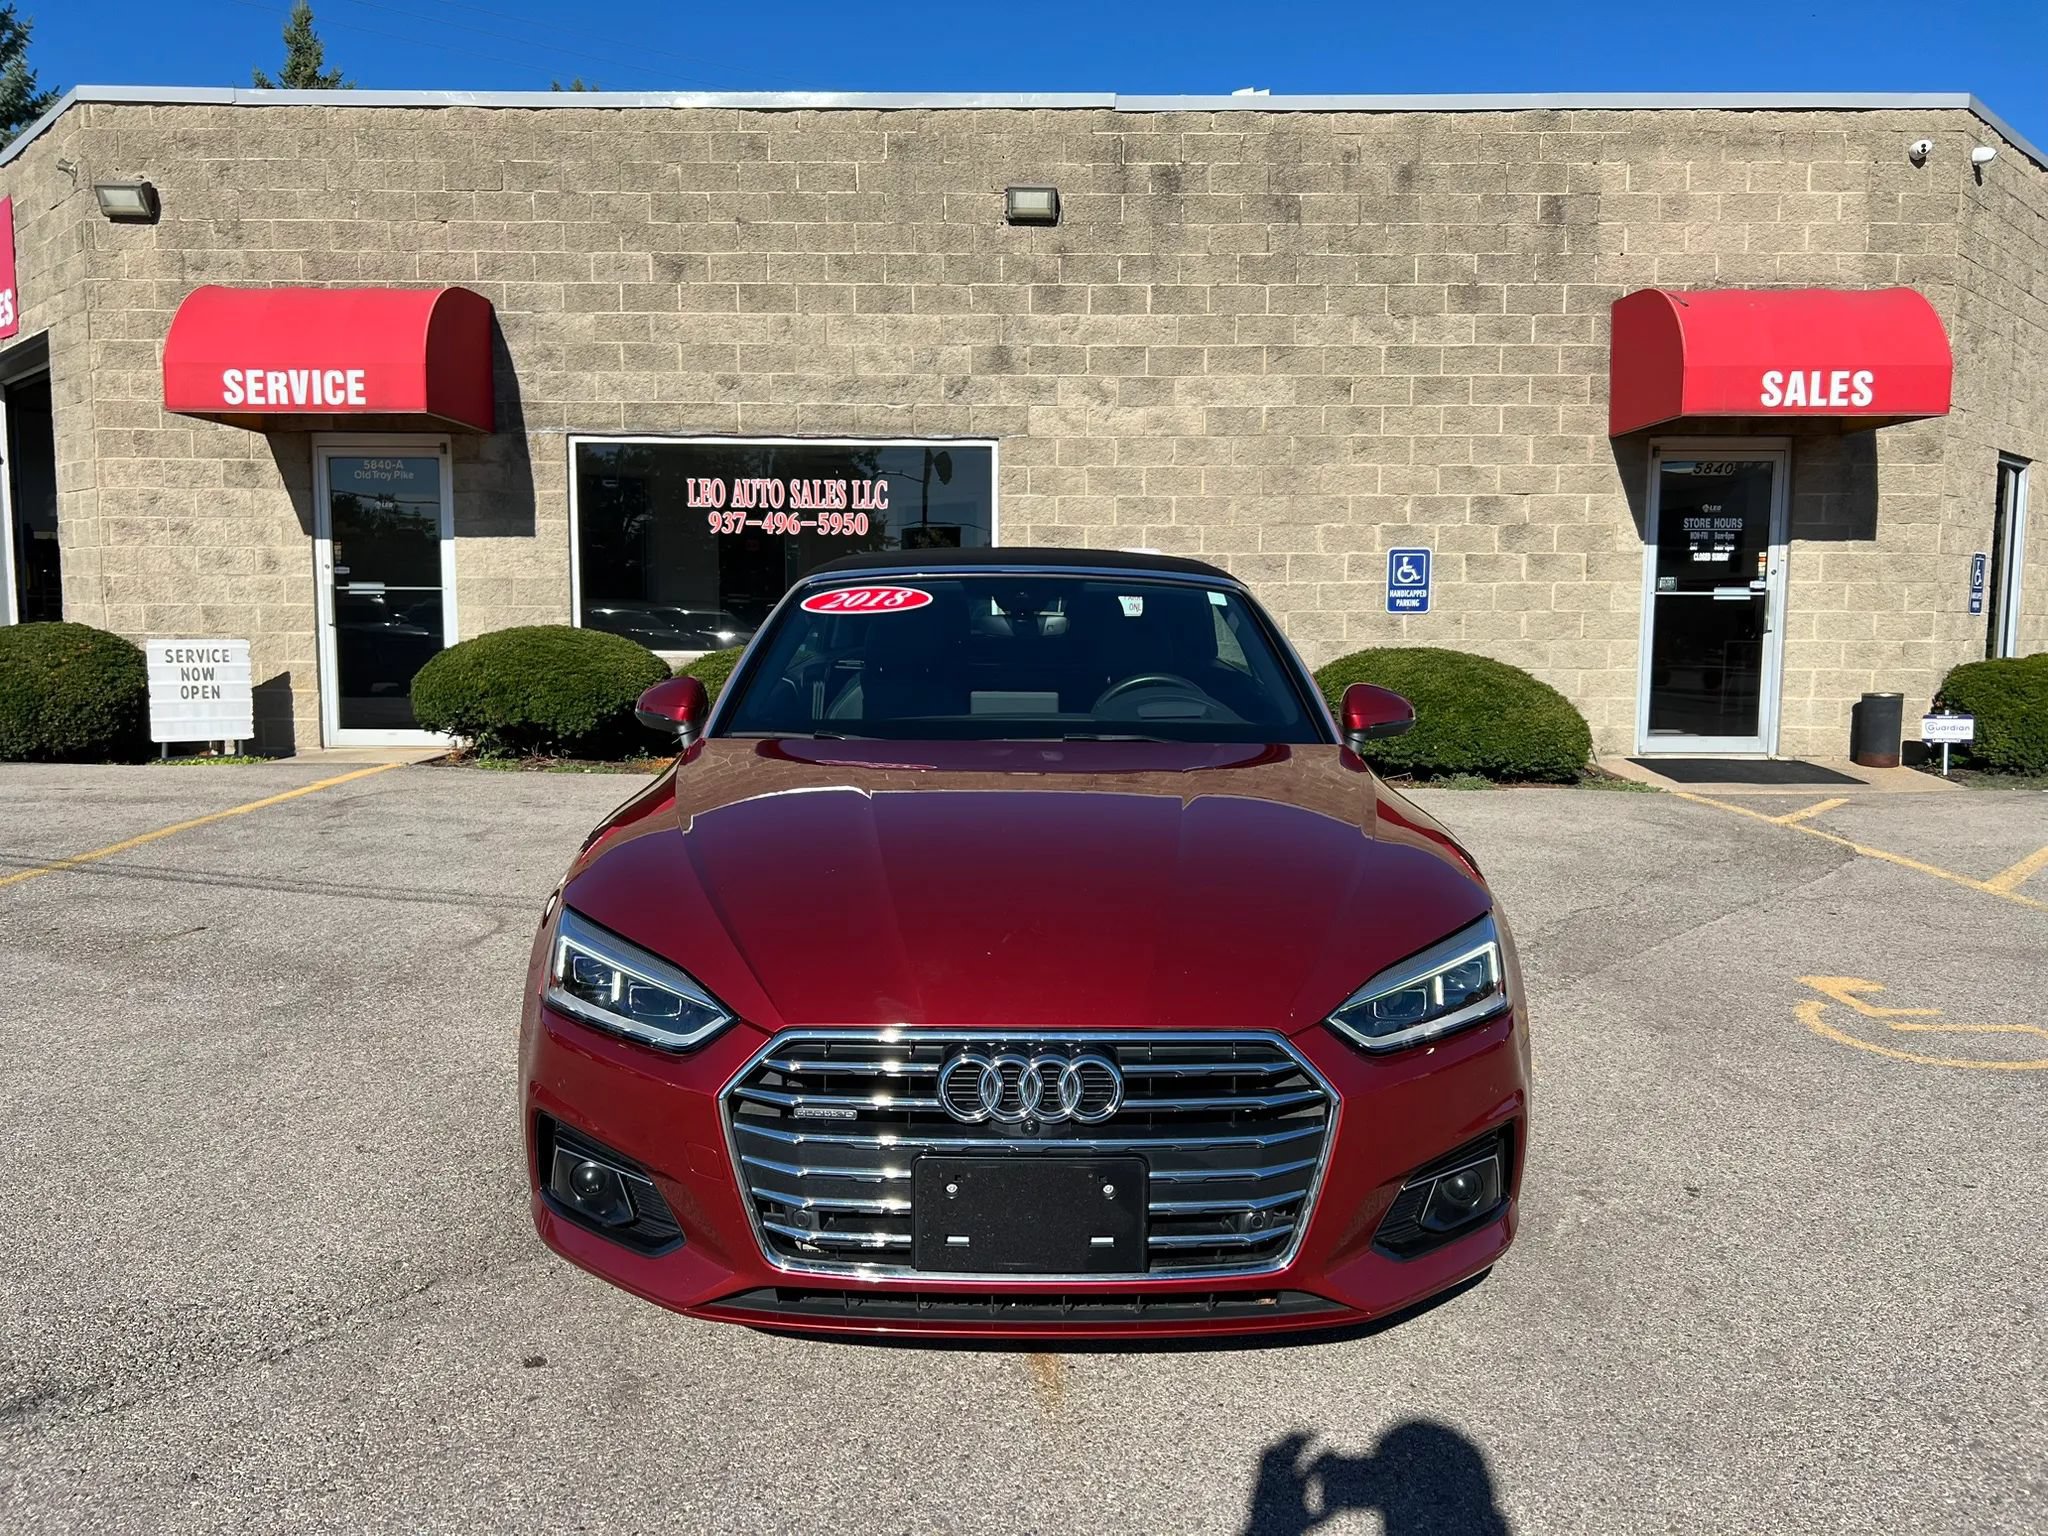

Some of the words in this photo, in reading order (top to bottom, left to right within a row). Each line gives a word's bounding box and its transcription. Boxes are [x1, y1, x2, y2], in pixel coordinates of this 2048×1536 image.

[223, 369, 366, 405] SERVICE
[1760, 370, 1874, 408] SALES
[363, 460, 404, 470] 5840-A
[1692, 462, 1735, 475] 5840
[354, 471, 372, 479] Old
[373, 471, 392, 481] Troy
[393, 471, 414, 479] Pike
[687, 478, 726, 508] LEO
[731, 479, 785, 509] AUTO
[790, 479, 846, 509] SALES
[852, 480, 889, 509] LLC
[708, 511, 869, 535] 937-496-5950
[1683, 518, 1711, 528] STORE
[1714, 518, 1743, 528] HOURS
[819, 590, 913, 610] 2018
[1396, 599, 1420, 607] PARKING
[165, 649, 230, 663] SERVICE
[181, 667, 215, 681] NOW
[180, 685, 221, 699] OPEN
